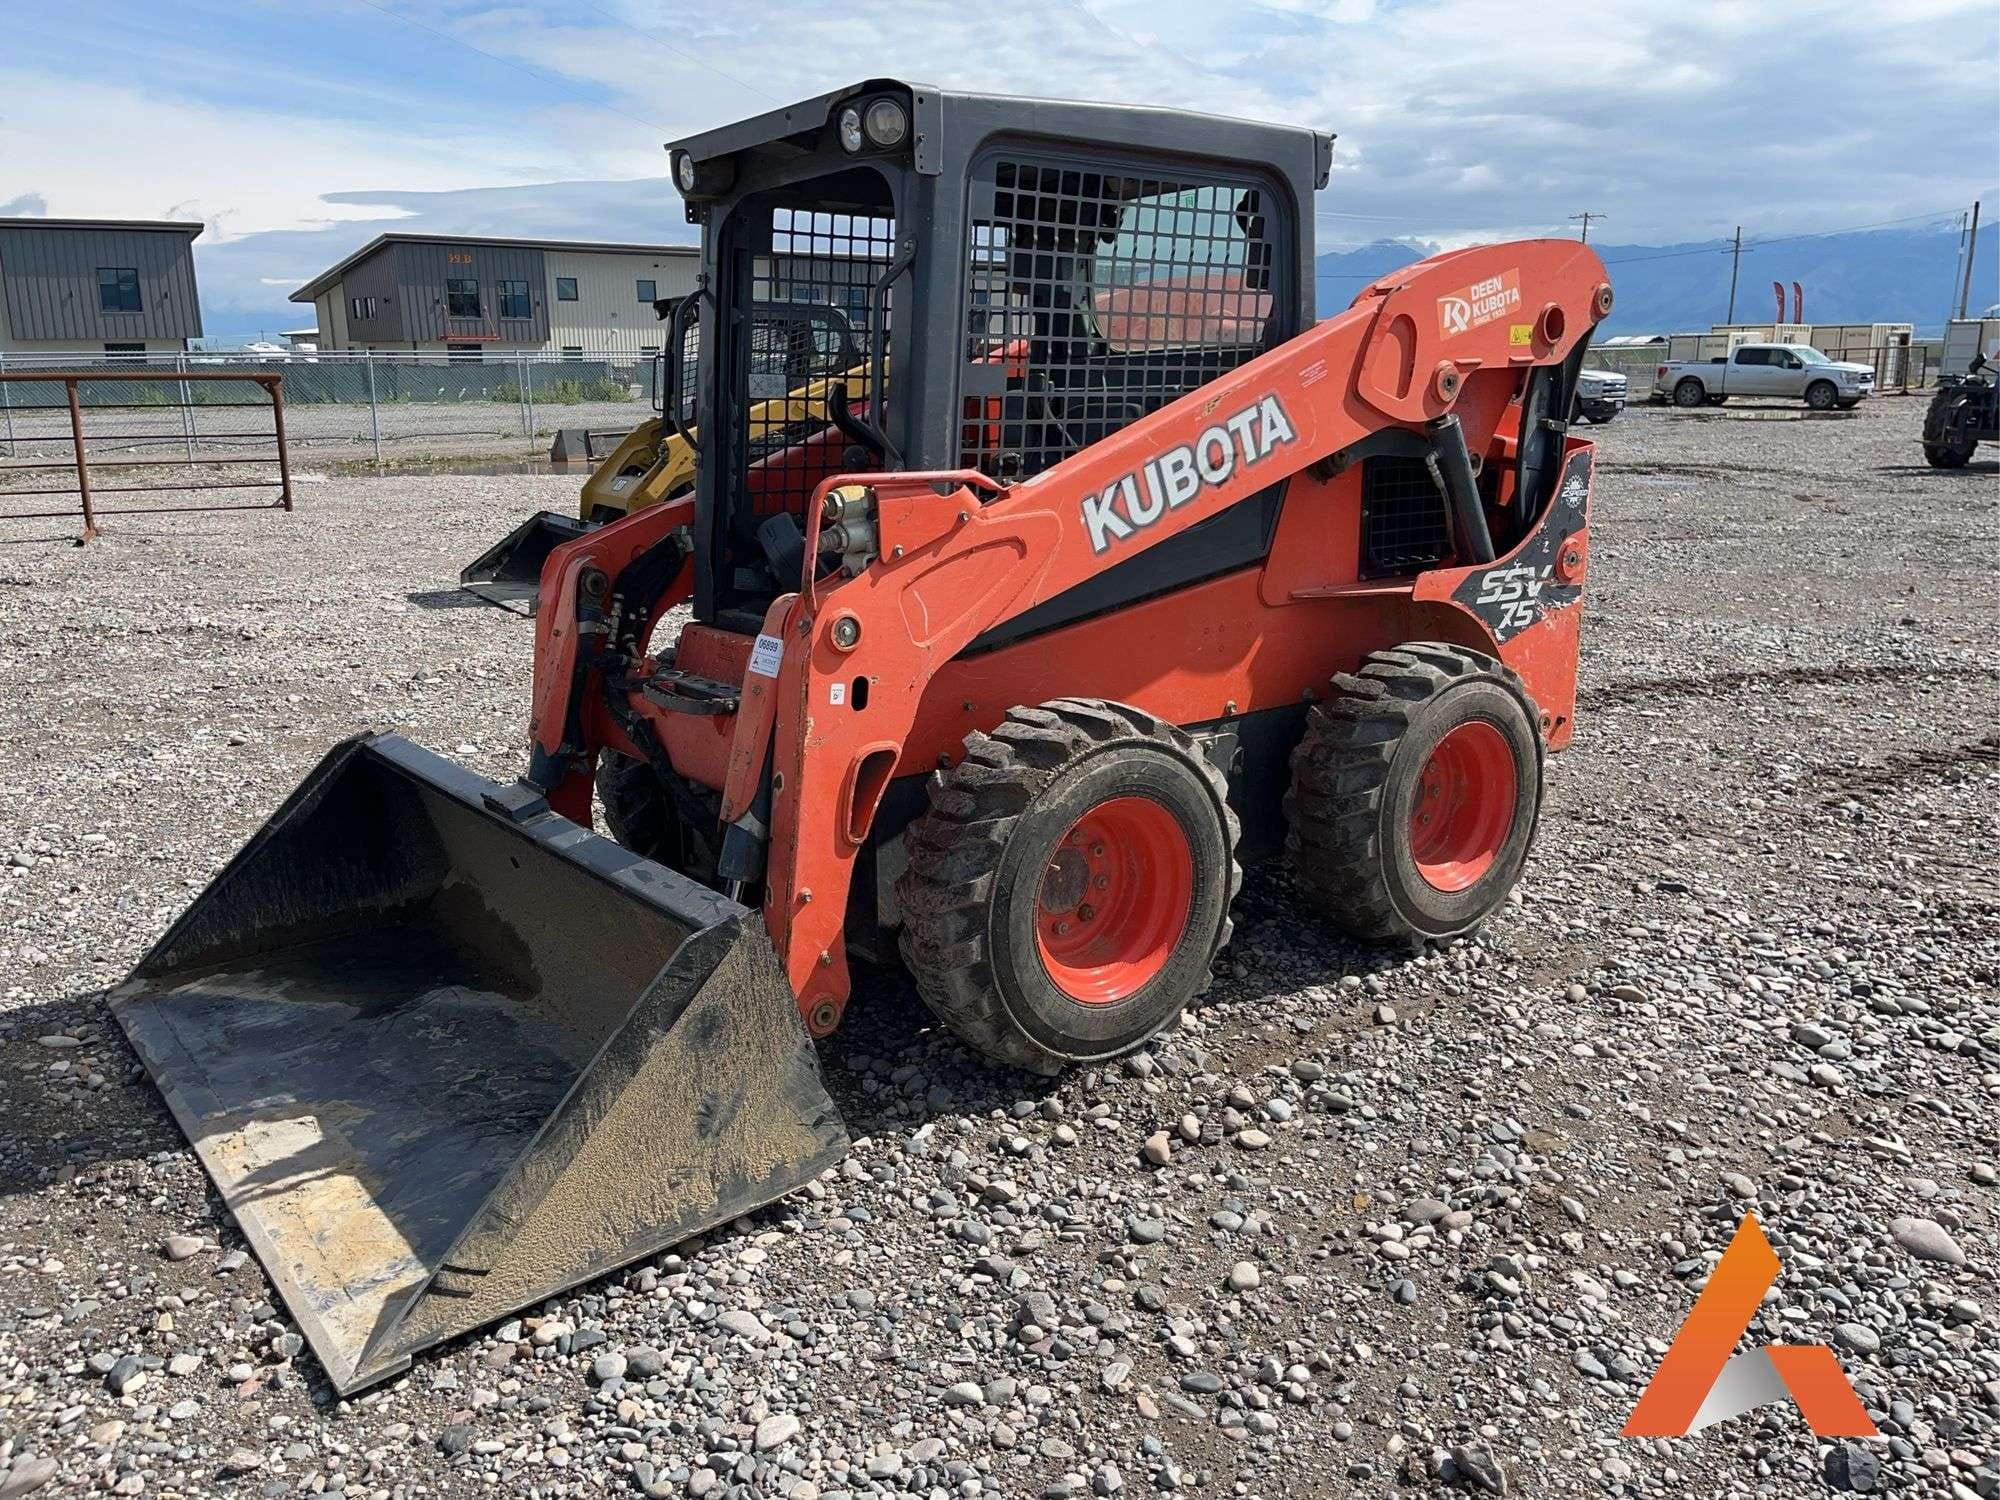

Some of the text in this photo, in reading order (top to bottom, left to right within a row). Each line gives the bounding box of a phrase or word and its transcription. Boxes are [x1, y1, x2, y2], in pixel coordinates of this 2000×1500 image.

[1471, 275, 1502, 301] DEEN
[1472, 288, 1520, 318] KUBOTA
[1081, 395, 1294, 553] KUBOTA
[1476, 565, 1552, 604] SSV
[1498, 600, 1535, 629] 75
